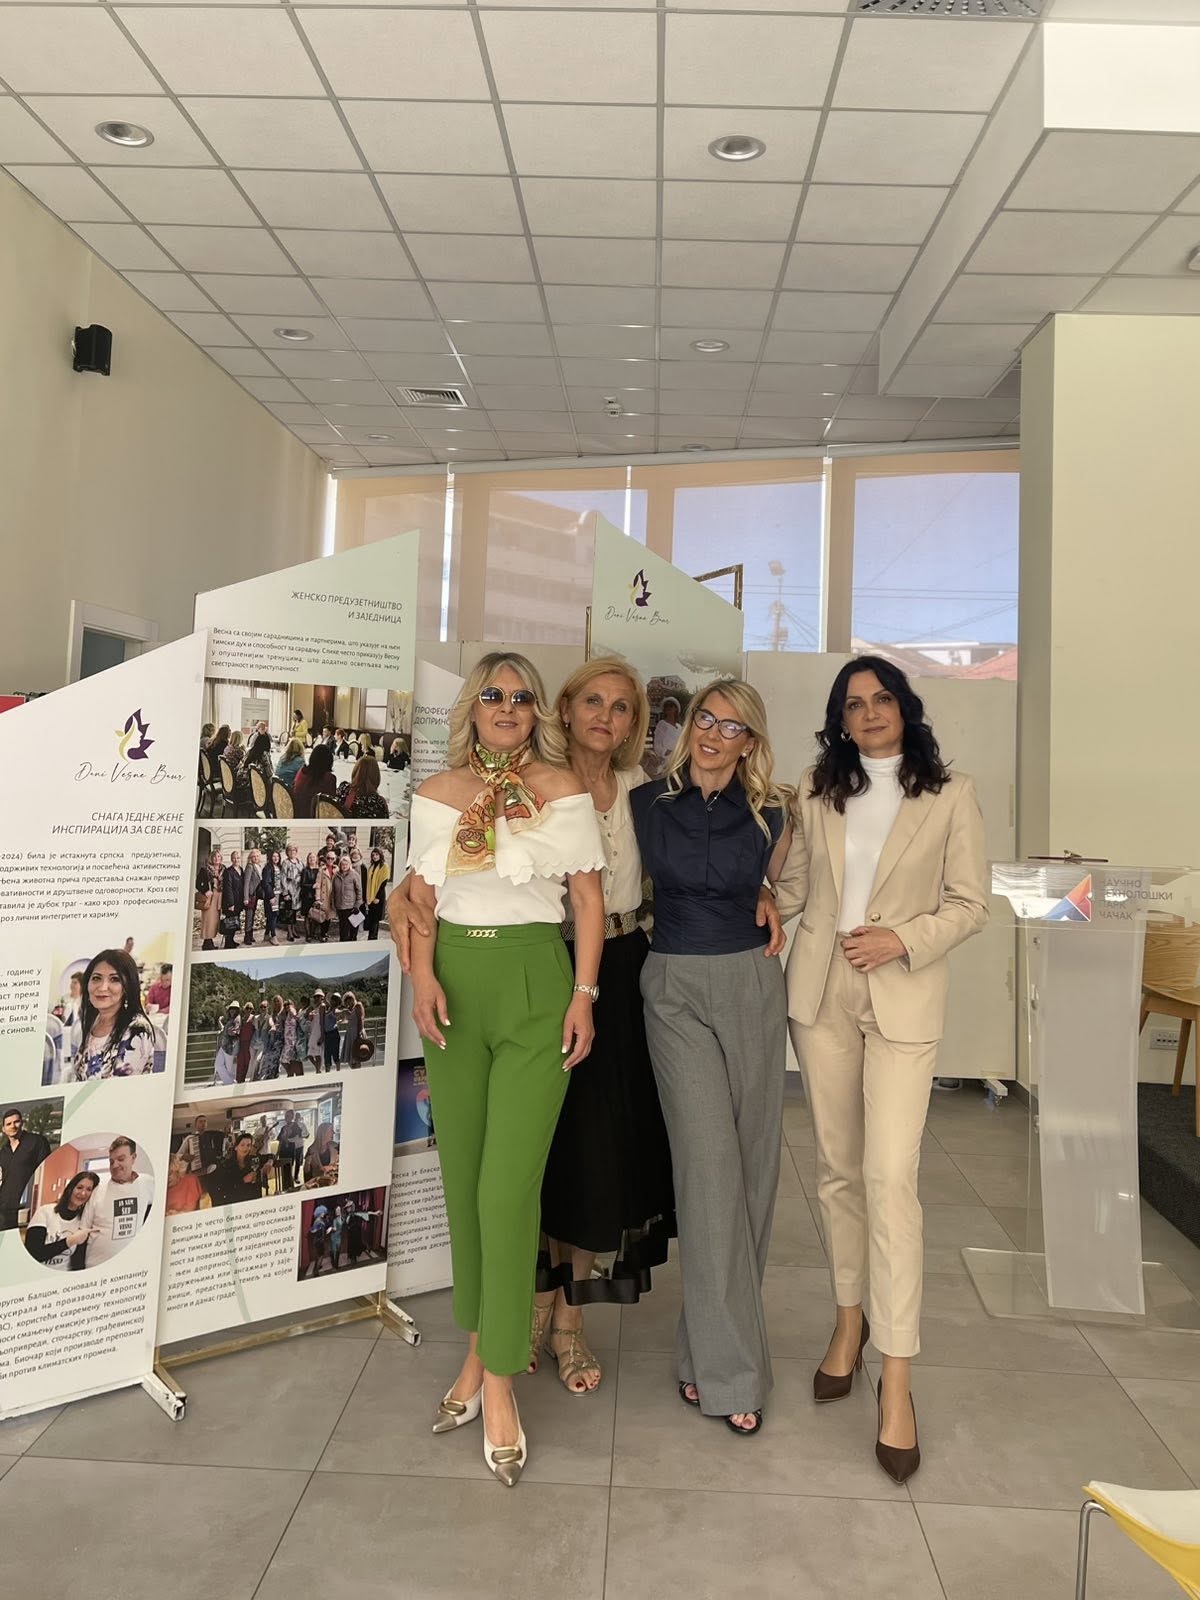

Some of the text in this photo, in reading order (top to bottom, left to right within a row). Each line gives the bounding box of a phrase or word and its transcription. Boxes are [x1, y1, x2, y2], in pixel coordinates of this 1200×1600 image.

[291, 591, 402, 610] ЖЕНСКО ПРЕДУЗЕТНИШТВО
[356, 612, 402, 624] ЗАЈЕДНИЦА
[92, 812, 184, 822] СНАГА ЈЕДНЕ ЖЕНЕ
[52, 825, 184, 834] ИНСПИРАЦИЈА ЗА СВЕ НАС
[36, 900, 60, 909] дубок
[1099, 911, 1133, 920] ЧАЧАК
